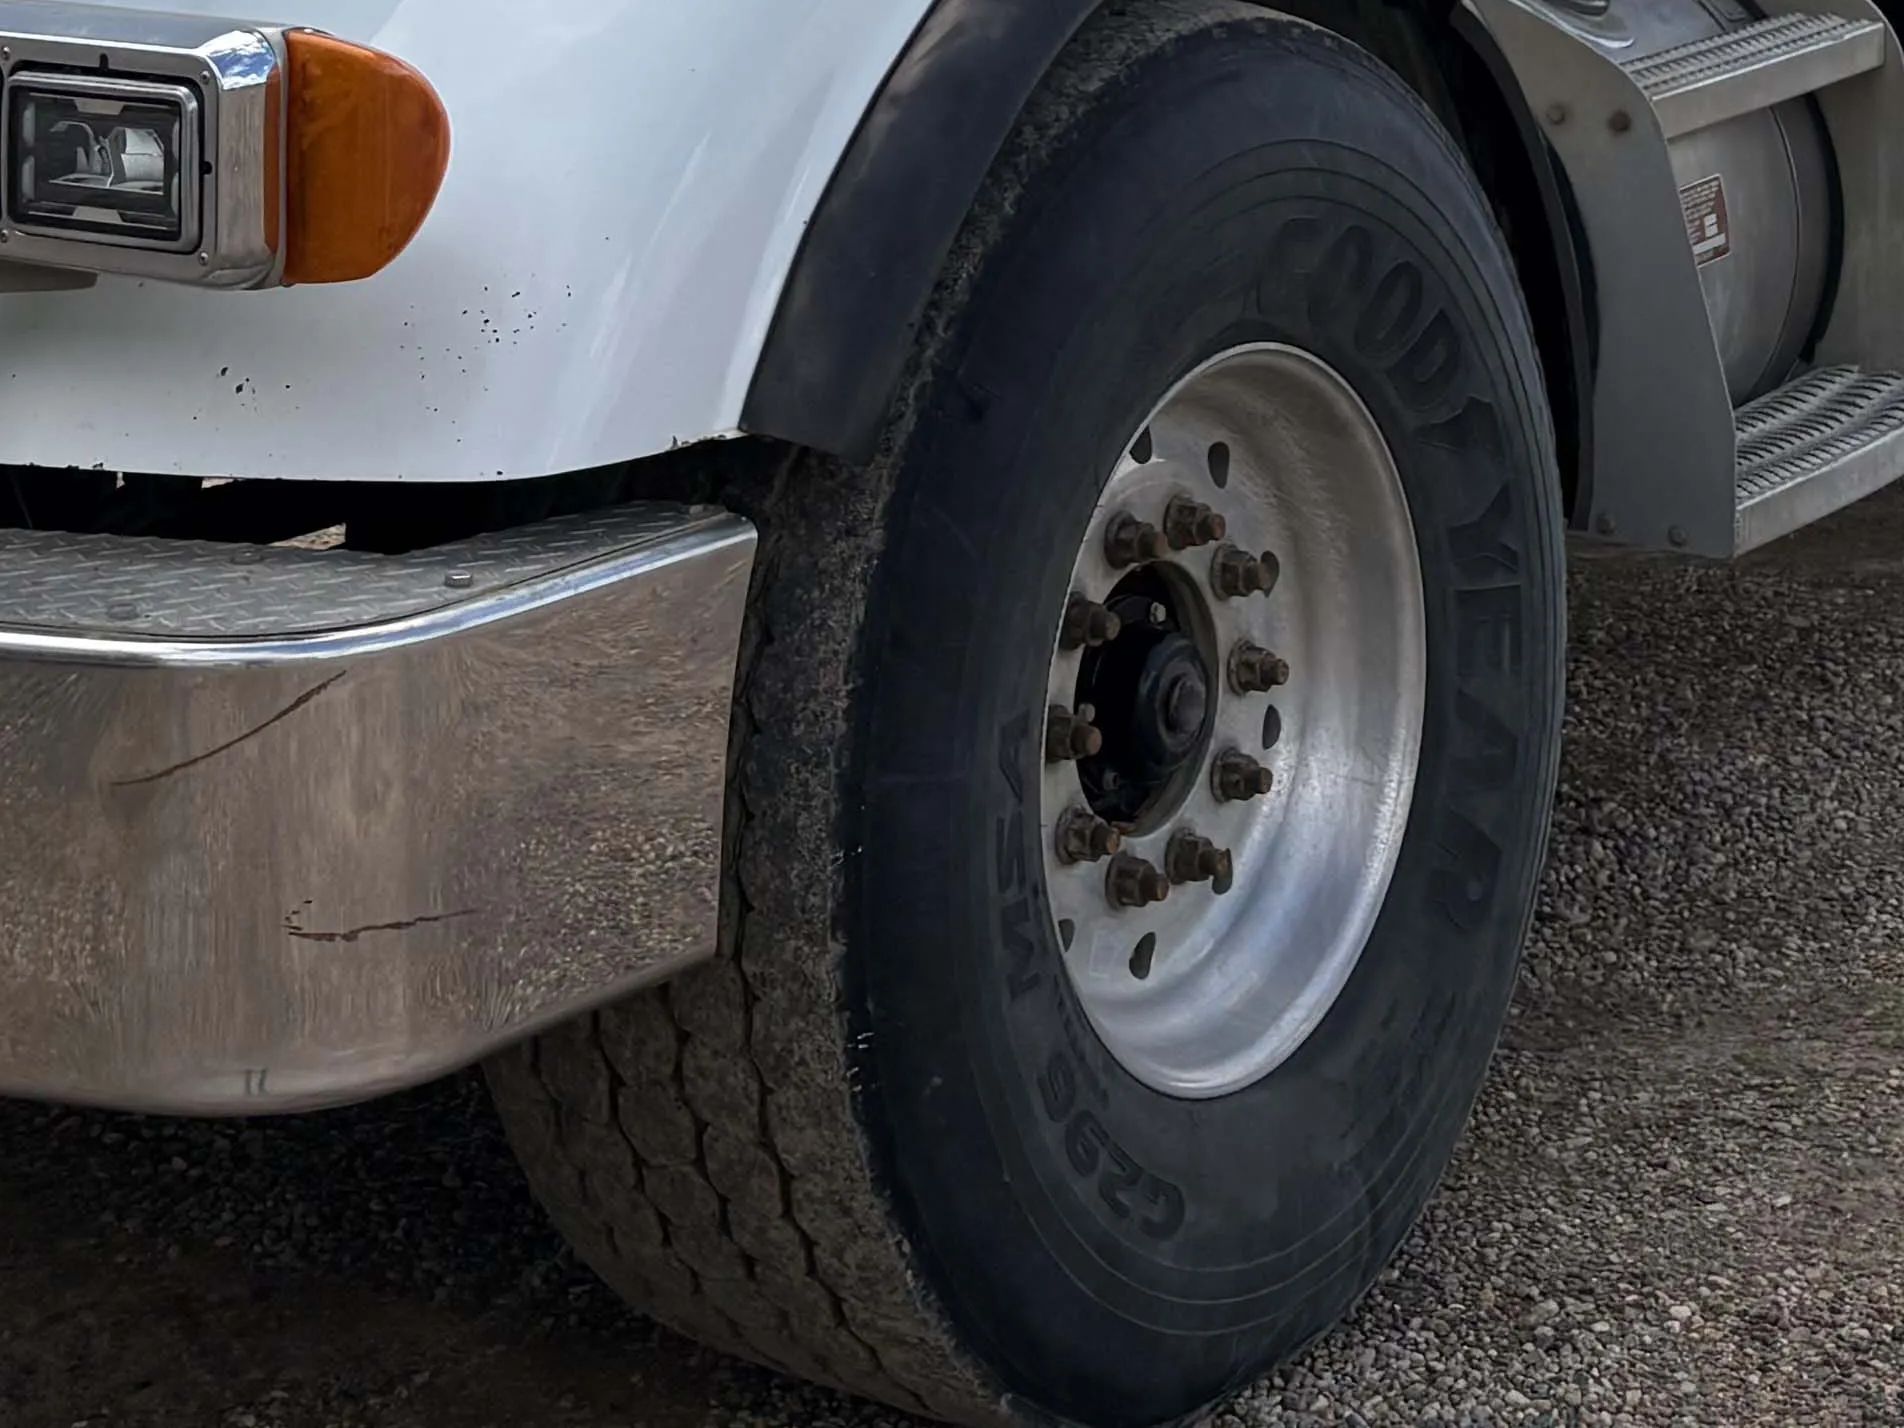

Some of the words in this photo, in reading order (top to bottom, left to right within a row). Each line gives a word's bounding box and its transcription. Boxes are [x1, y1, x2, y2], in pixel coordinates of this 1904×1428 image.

[1254, 212, 1524, 934] GOODYEAR
[995, 706, 1043, 1004] MSA
[1036, 1047, 1186, 1242] G296
